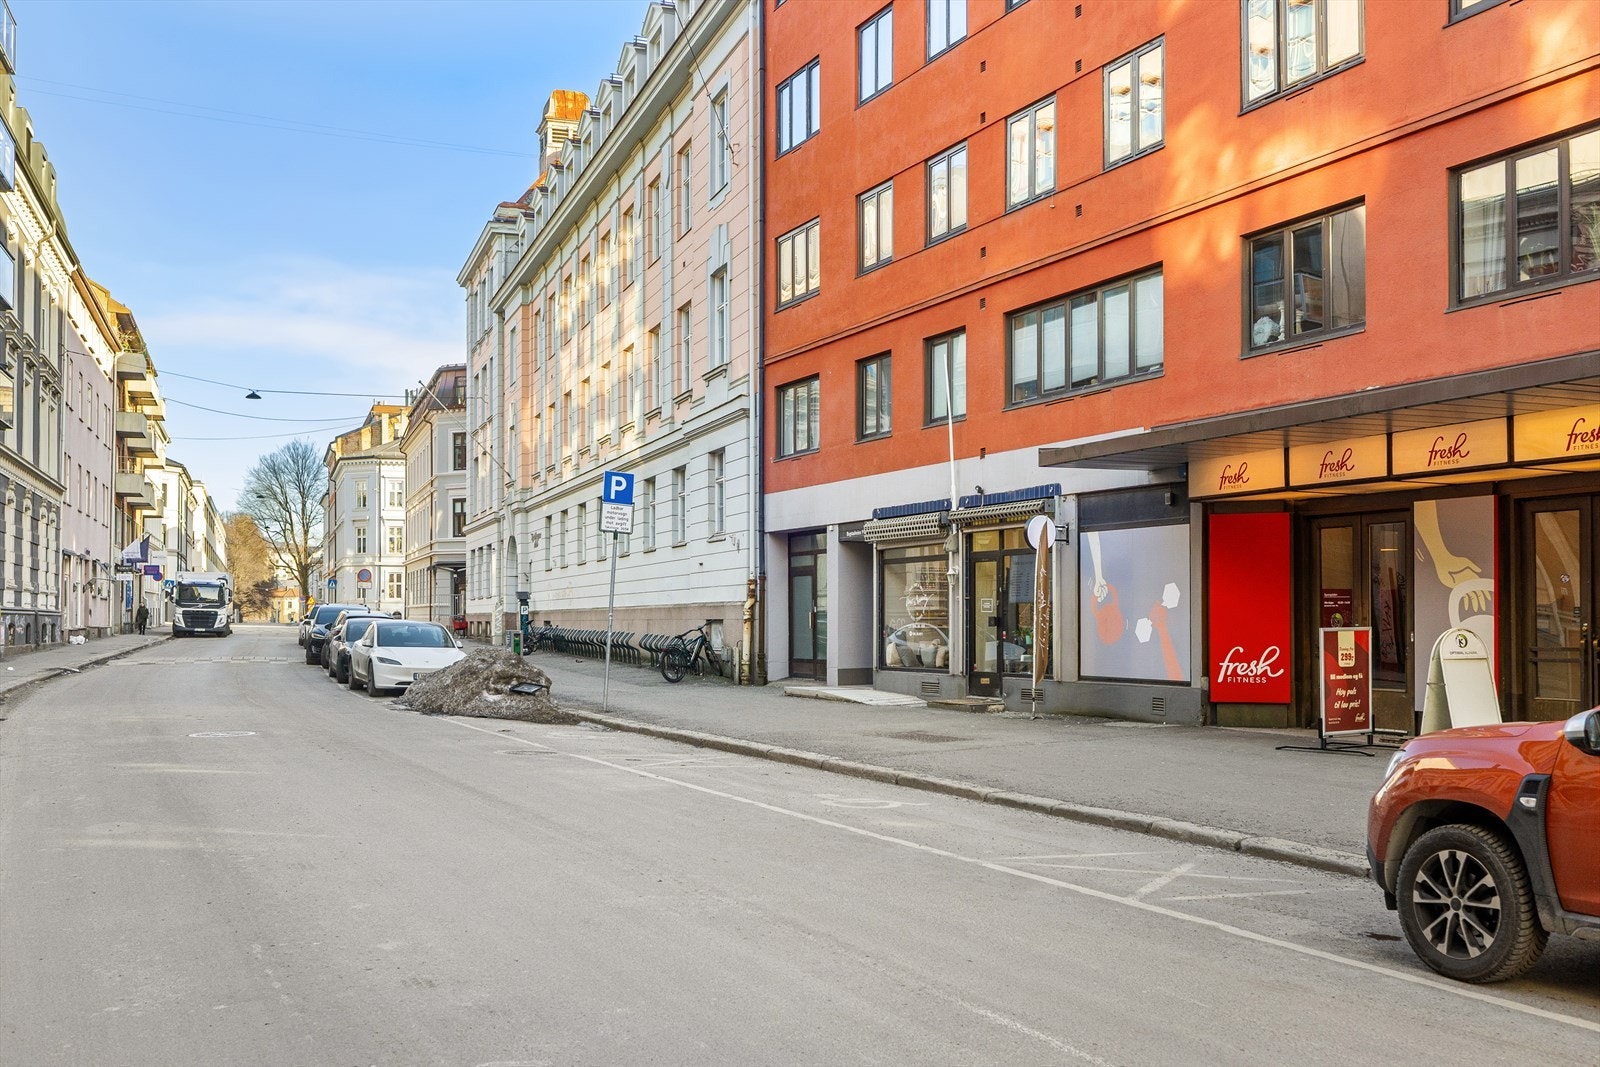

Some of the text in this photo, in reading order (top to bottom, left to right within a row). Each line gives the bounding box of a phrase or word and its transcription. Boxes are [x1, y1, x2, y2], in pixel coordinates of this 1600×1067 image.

[1428, 432, 1470, 466] fresh
[1566, 418, 1600, 451] fres
[1219, 462, 1250, 490] fresh
[1319, 448, 1354, 478] fresh
[610, 476, 627, 499] P
[1218, 646, 1284, 682] fresh
